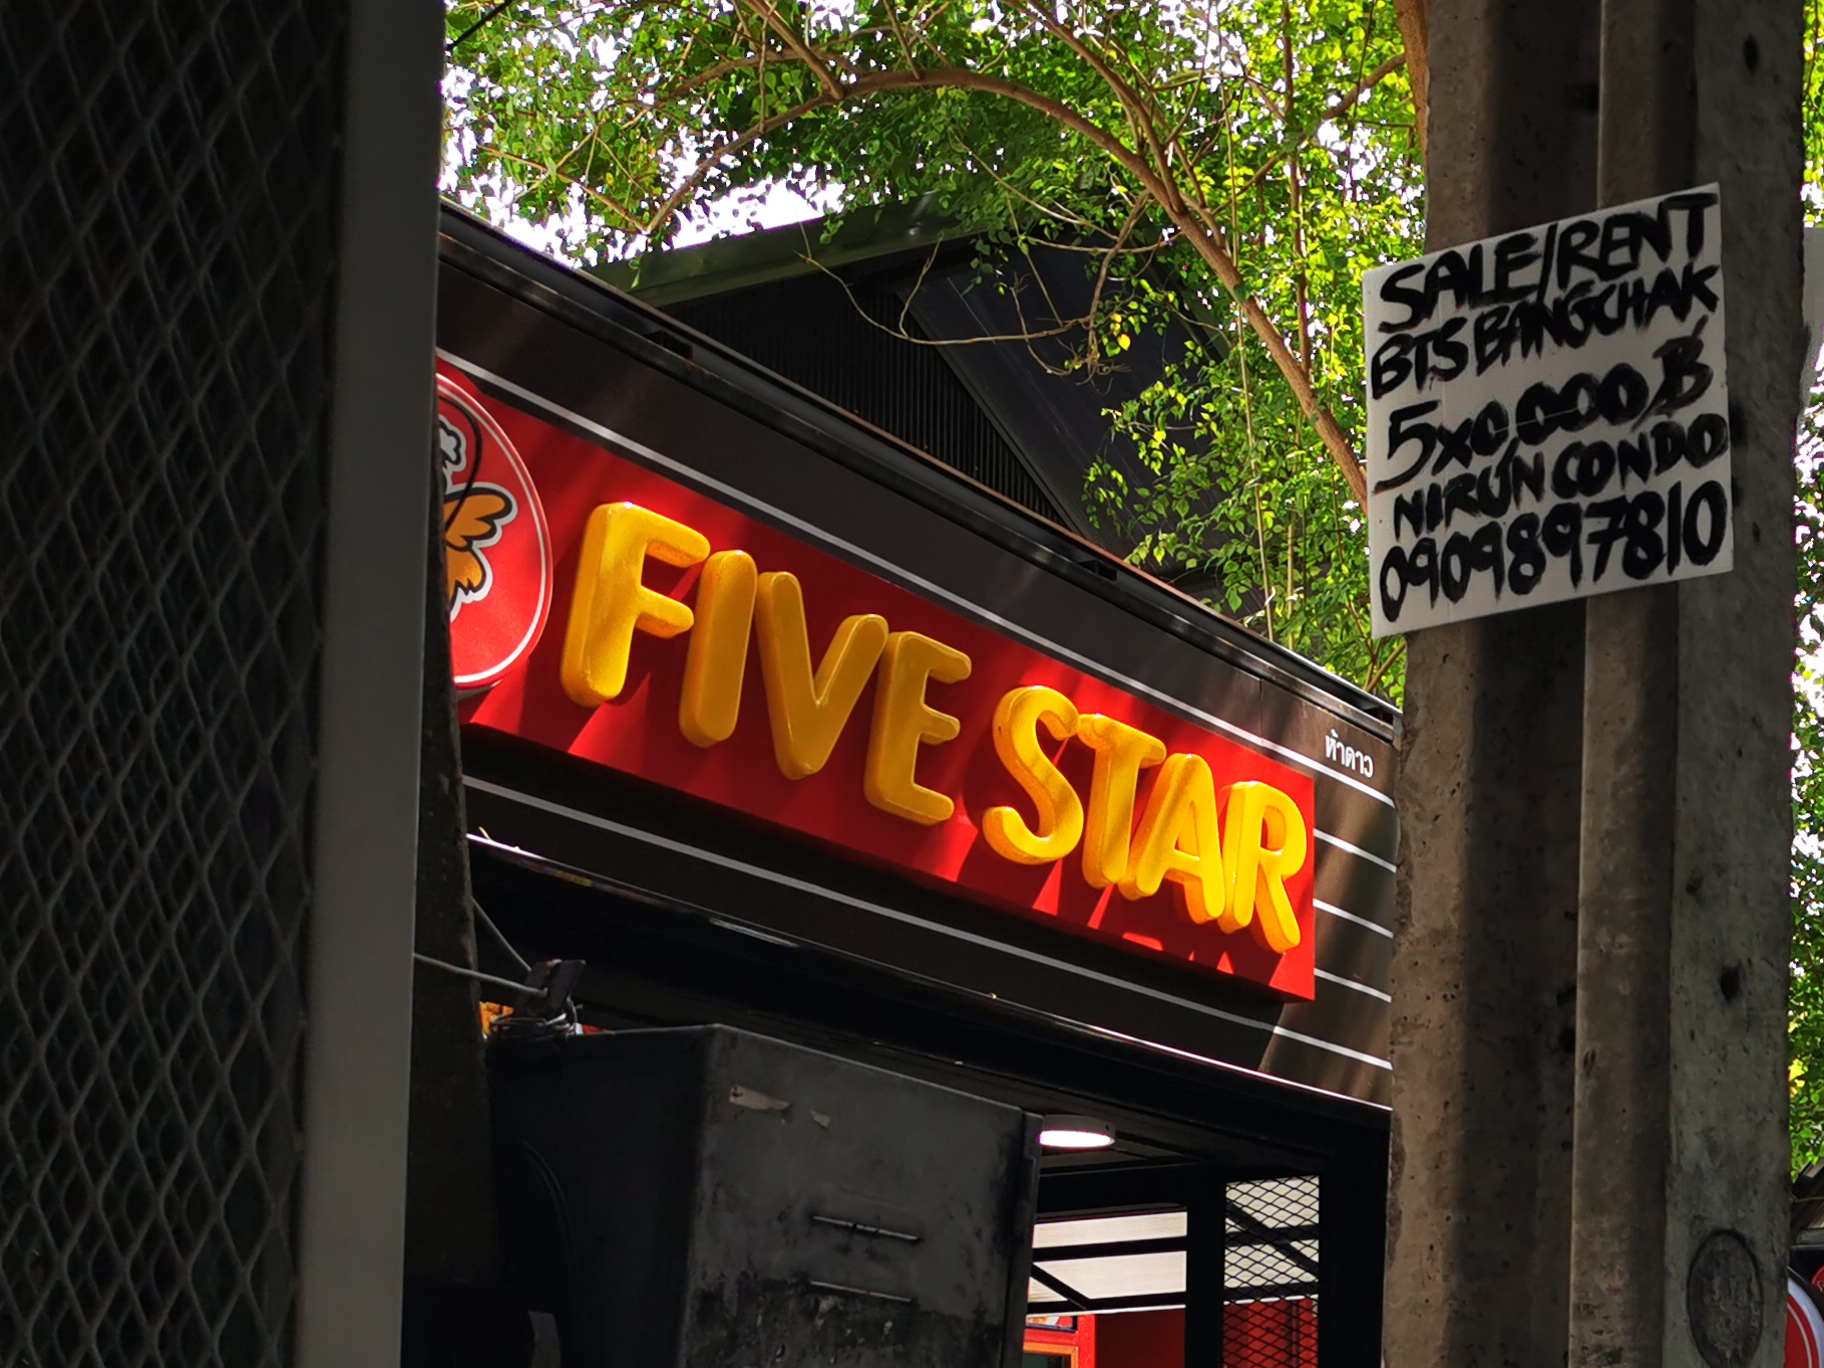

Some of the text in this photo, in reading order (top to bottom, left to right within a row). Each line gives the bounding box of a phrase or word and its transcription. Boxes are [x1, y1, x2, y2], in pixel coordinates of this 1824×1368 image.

[1371, 265, 1720, 399] BTS BANGCHAK
[1378, 192, 1718, 334] SALE/RENT
[1394, 412, 1729, 541] NIRUN CONDO
[1380, 479, 1728, 622] 0909897810
[560, 500, 1309, 954] FIVE STAR
[1325, 728, 1374, 778] ห้าดาว
